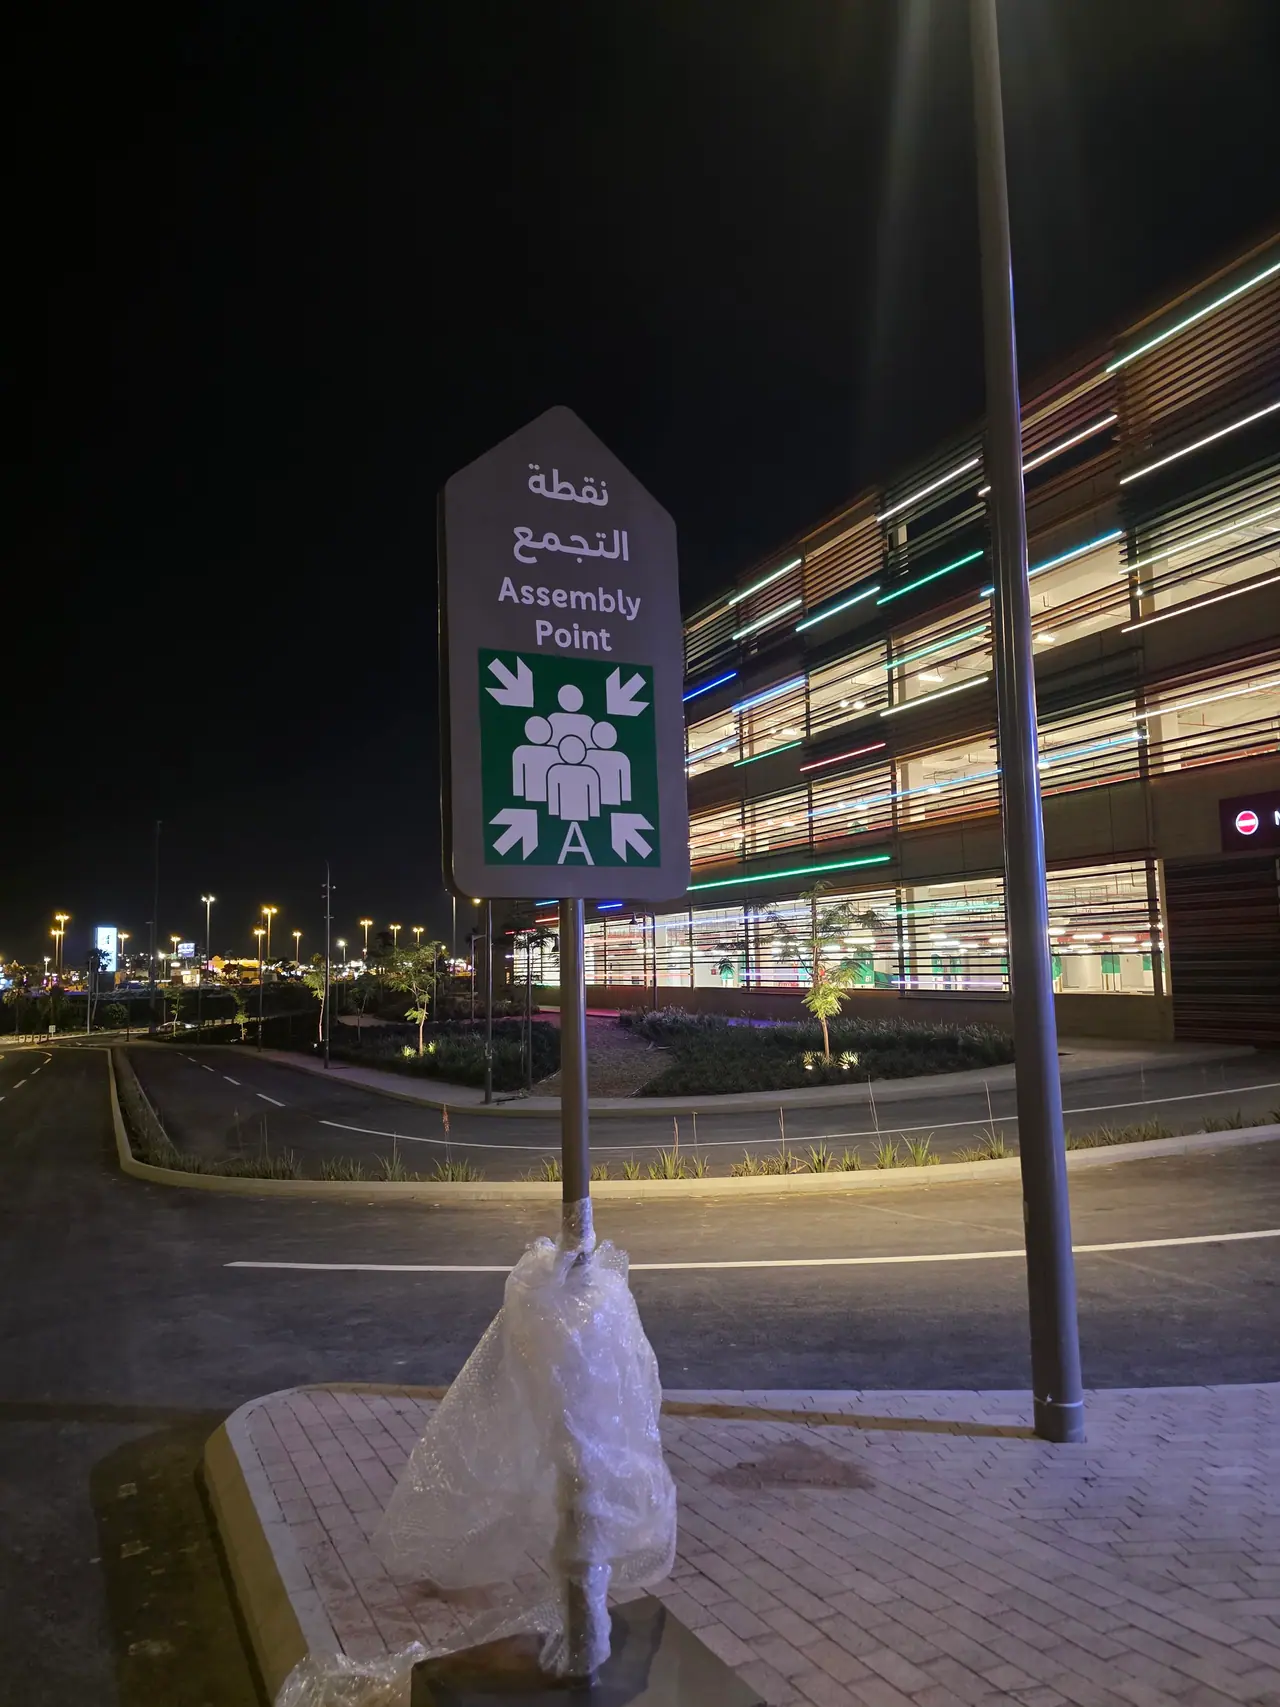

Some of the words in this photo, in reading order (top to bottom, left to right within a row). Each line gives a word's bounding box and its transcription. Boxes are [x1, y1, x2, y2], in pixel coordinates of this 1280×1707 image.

[528, 463, 609, 506] نقطة
[513, 526, 629, 564] التجمع
[498, 576, 641, 621] Assembly
[535, 619, 613, 652] Point
[557, 821, 595, 866] A
